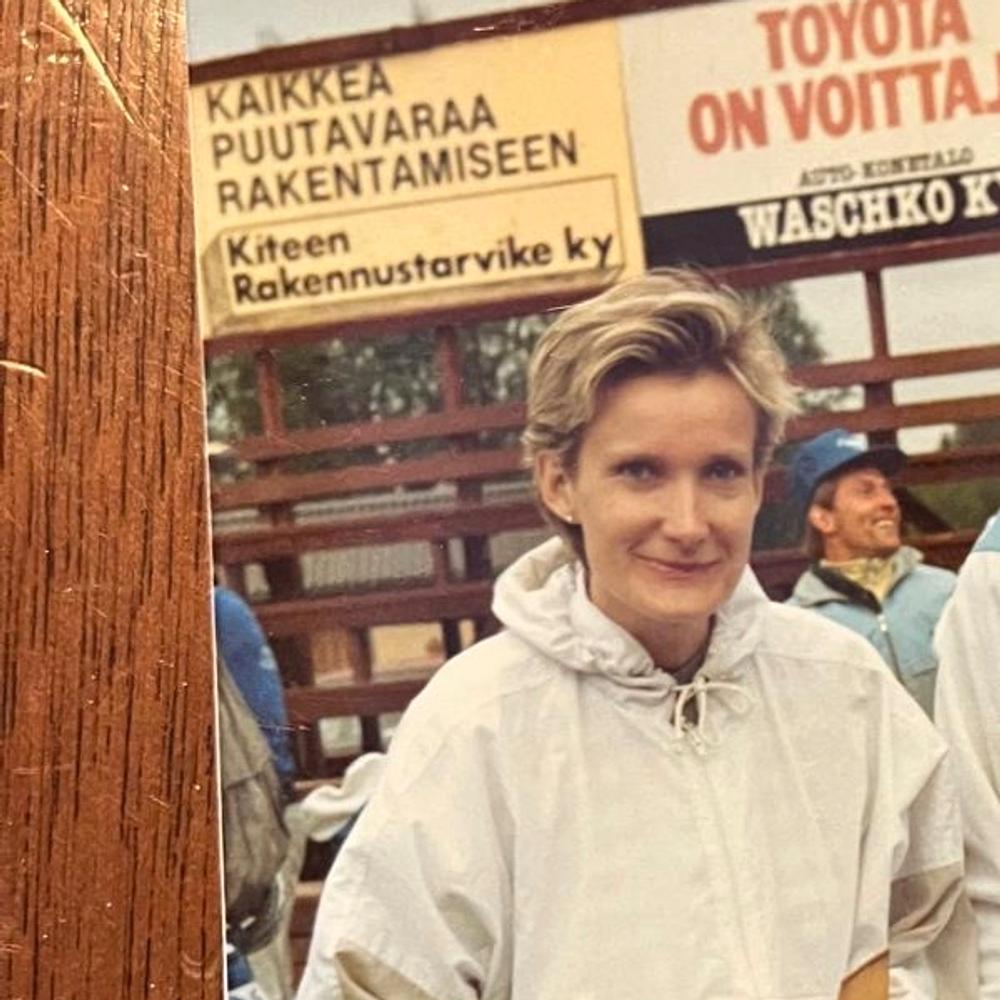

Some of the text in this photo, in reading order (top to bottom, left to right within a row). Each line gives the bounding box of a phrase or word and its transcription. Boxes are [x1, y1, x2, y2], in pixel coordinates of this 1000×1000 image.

[757, 0, 970, 71] TOYOTA
[205, 60, 393, 122] KAIKKEA
[688, 86, 769, 154] ON
[211, 94, 497, 169] PUUTAVARAA
[217, 130, 578, 215] RAKENTAMISEEN
[227, 228, 350, 268] Kiteen
[738, 178, 955, 249] WASCHKO
[233, 227, 613, 304] Rakennustarvike ky
